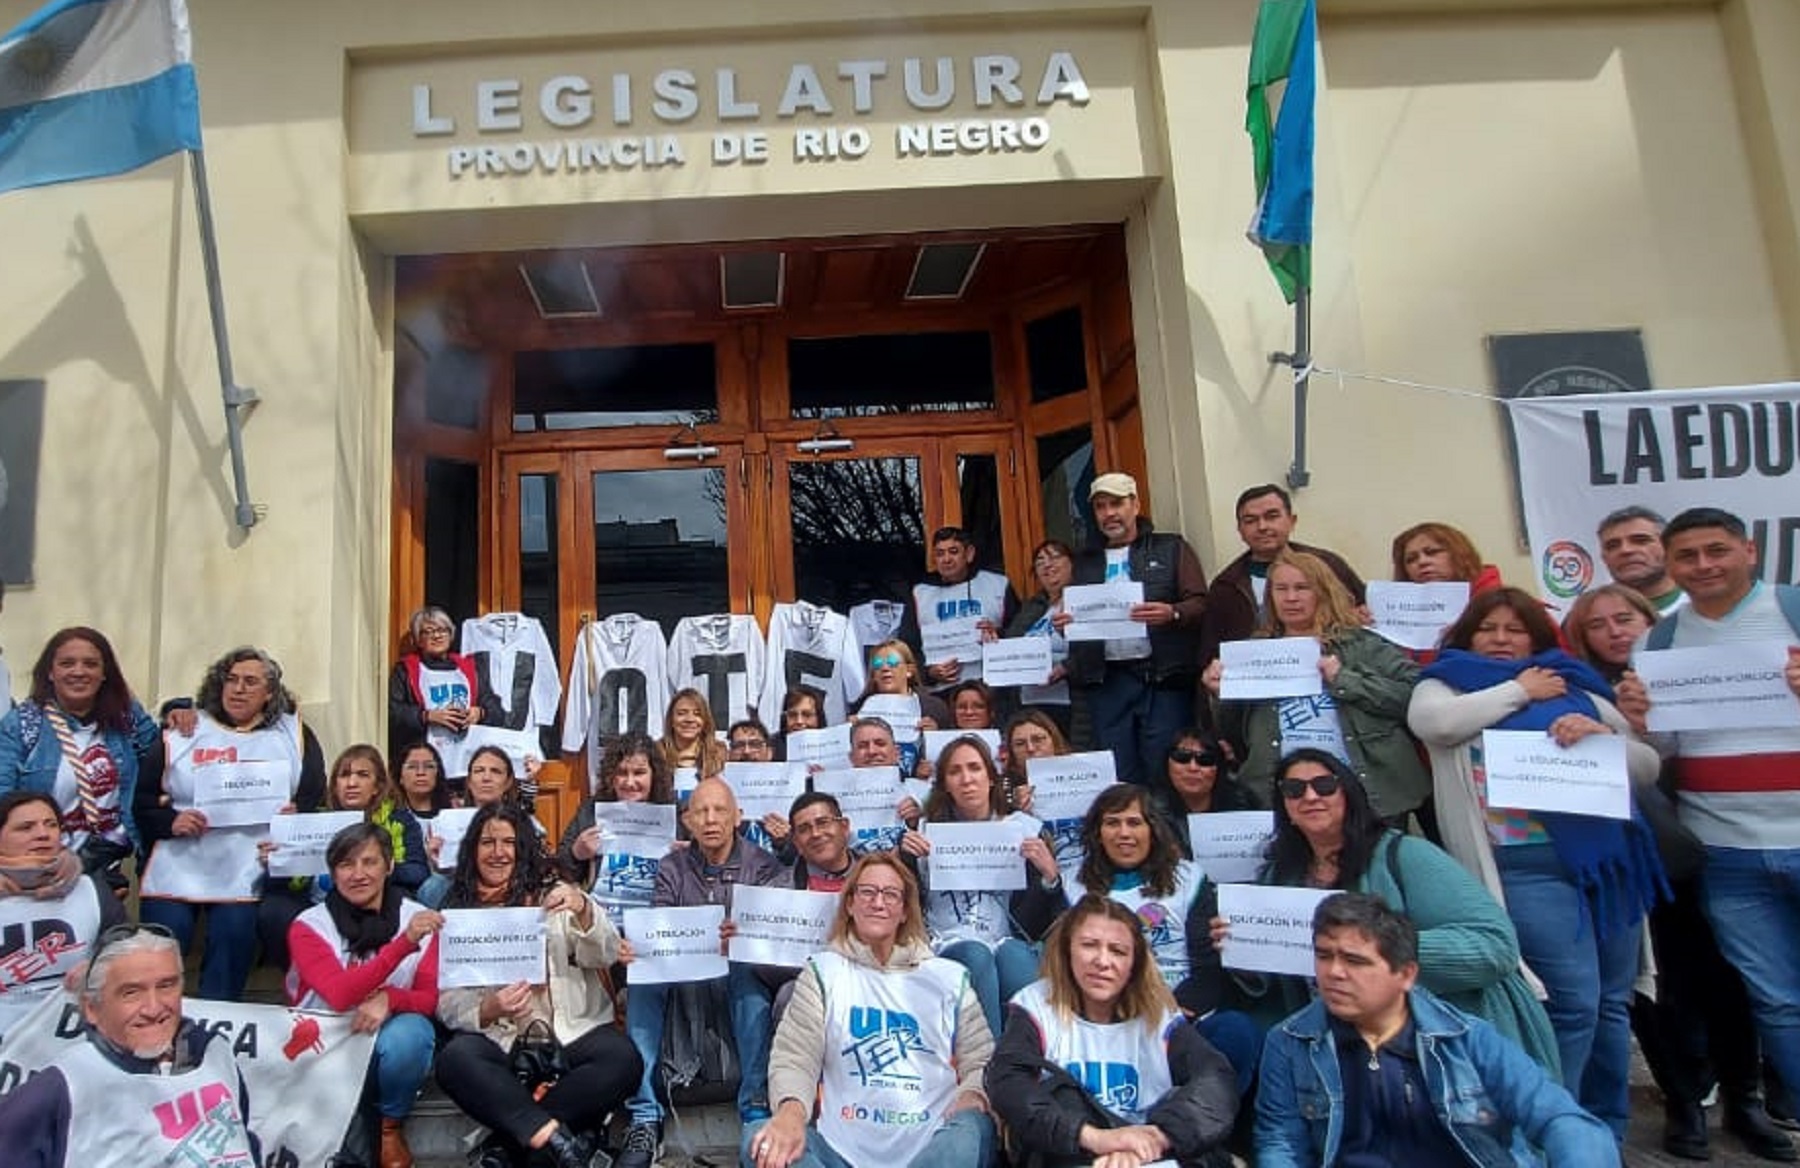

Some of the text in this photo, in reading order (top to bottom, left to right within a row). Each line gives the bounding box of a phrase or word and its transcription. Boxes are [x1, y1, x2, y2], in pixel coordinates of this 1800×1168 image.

[412, 51, 1091, 136] LEGISLATURA
[448, 117, 1051, 175] PROVINCIA DE RIO NEGRO
[1582, 401, 1800, 486] LA EDU
[840, 1102, 931, 1126] RÍO NEGRO
